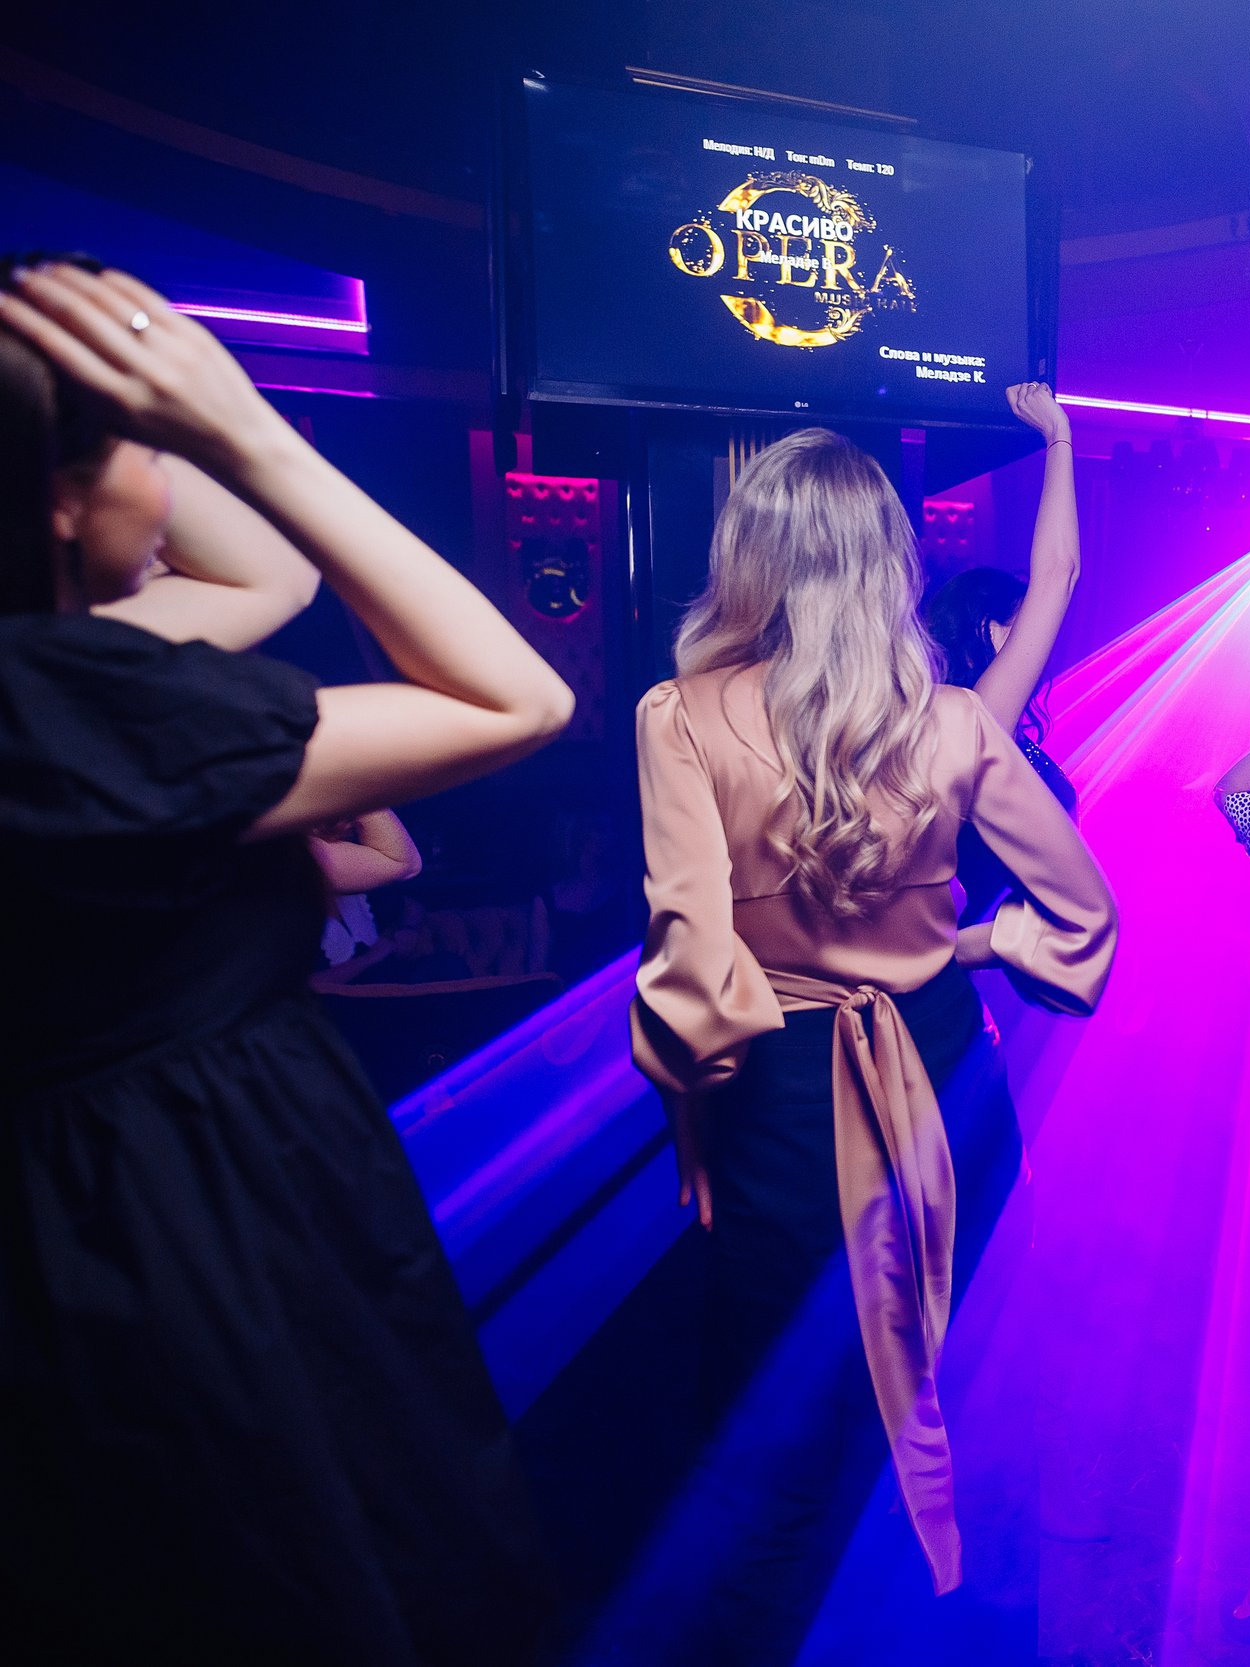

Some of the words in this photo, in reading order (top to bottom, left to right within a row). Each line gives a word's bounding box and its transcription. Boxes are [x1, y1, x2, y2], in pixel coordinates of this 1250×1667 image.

[875, 163, 895, 176] 120
[736, 209, 854, 242] КРАСИВО
[668, 222, 917, 300] OPERA
[814, 291, 869, 307] MUS
[879, 345, 921, 362] Слова
[922, 351, 932, 363] и
[933, 353, 986, 367] музыка:
[915, 365, 972, 383] Меладзе
